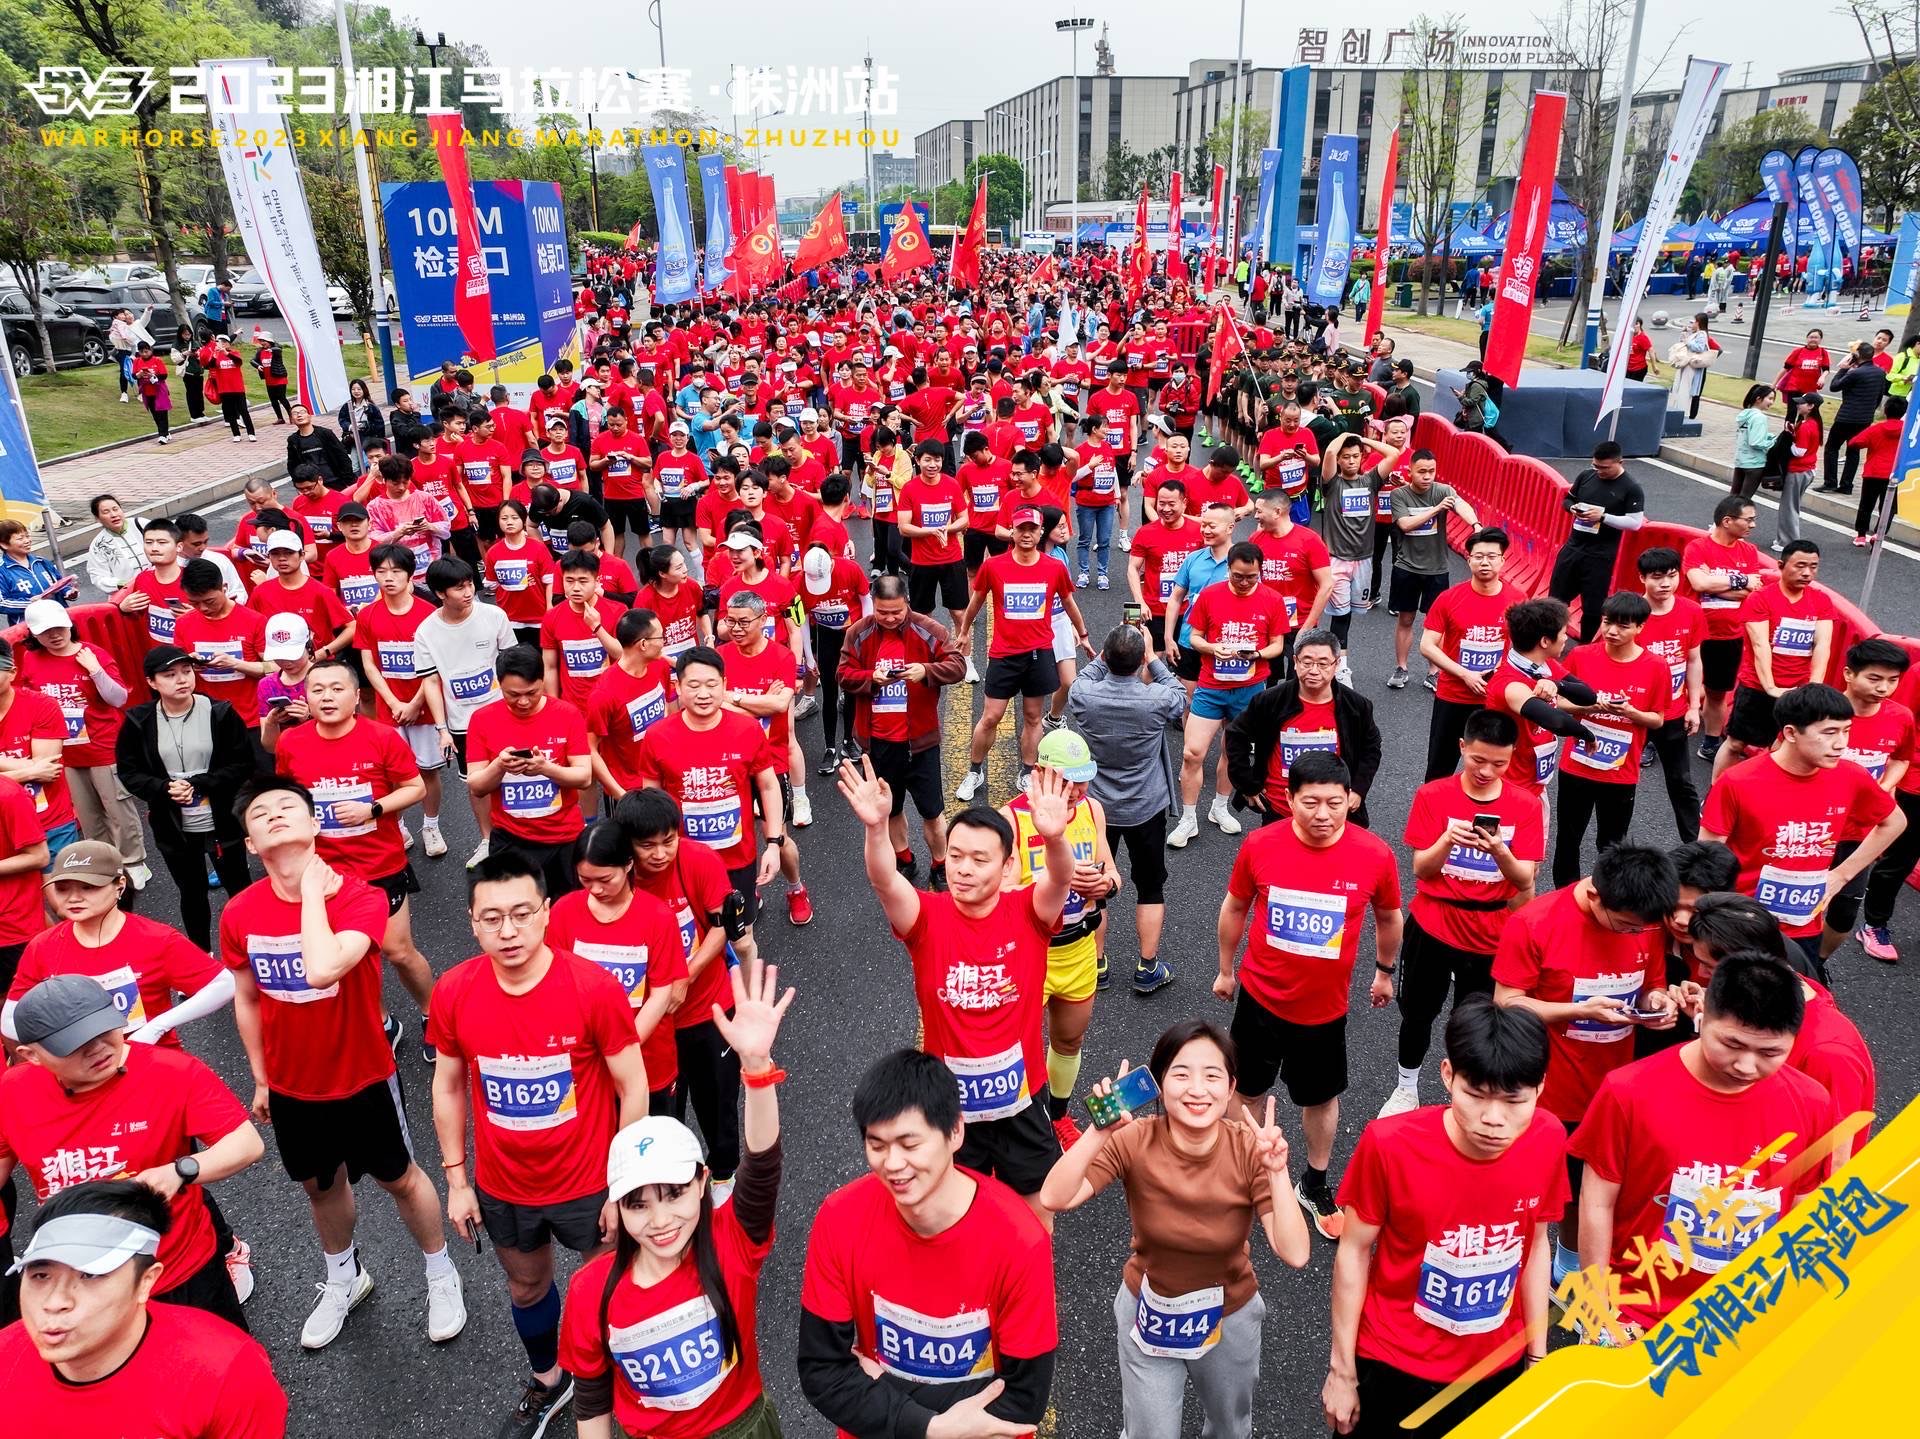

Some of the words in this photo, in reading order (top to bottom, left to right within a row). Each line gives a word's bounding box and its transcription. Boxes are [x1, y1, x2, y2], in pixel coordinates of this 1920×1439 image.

[1299, 28, 1458, 64] 智创广场
[1462, 36, 1552, 48] INNOVATION
[1462, 52, 1521, 64] WISDOM
[1526, 52, 1574, 64] PLAZA
[408, 206, 503, 237] 10M
[532, 206, 561, 234] 10KM
[536, 243, 566, 276] 检录口
[922, 511, 950, 523] B1097
[496, 569, 523, 581] B2145
[343, 586, 376, 600] B1473
[1005, 594, 1041, 608] B1421
[150, 617, 175, 632] B142
[813, 611, 845, 623] B2073
[566, 651, 603, 665] B1635
[1461, 652, 1498, 667] B1281
[452, 674, 491, 693] B1643
[875, 685, 908, 698] 1600
[633, 700, 665, 728] B1598
[682, 766, 730, 786] 湘江
[504, 782, 555, 801] B1284
[686, 812, 736, 836] B1264
[1776, 820, 1835, 845] 湘江
[1029, 841, 1093, 873] CNA
[1758, 881, 1822, 906] B1645
[1271, 906, 1334, 936] B1369
[254, 956, 305, 980] B119
[945, 961, 1013, 990] 湘江
[486, 1079, 561, 1104] B1629
[41, 1145, 128, 1180] 湘江
[1439, 1220, 1525, 1258] 湘江
[1425, 1271, 1511, 1307] B1614
[1138, 1298, 1210, 1338] B2144
[621, 1328, 720, 1383] B2165
[881, 1323, 976, 1366] B1404
